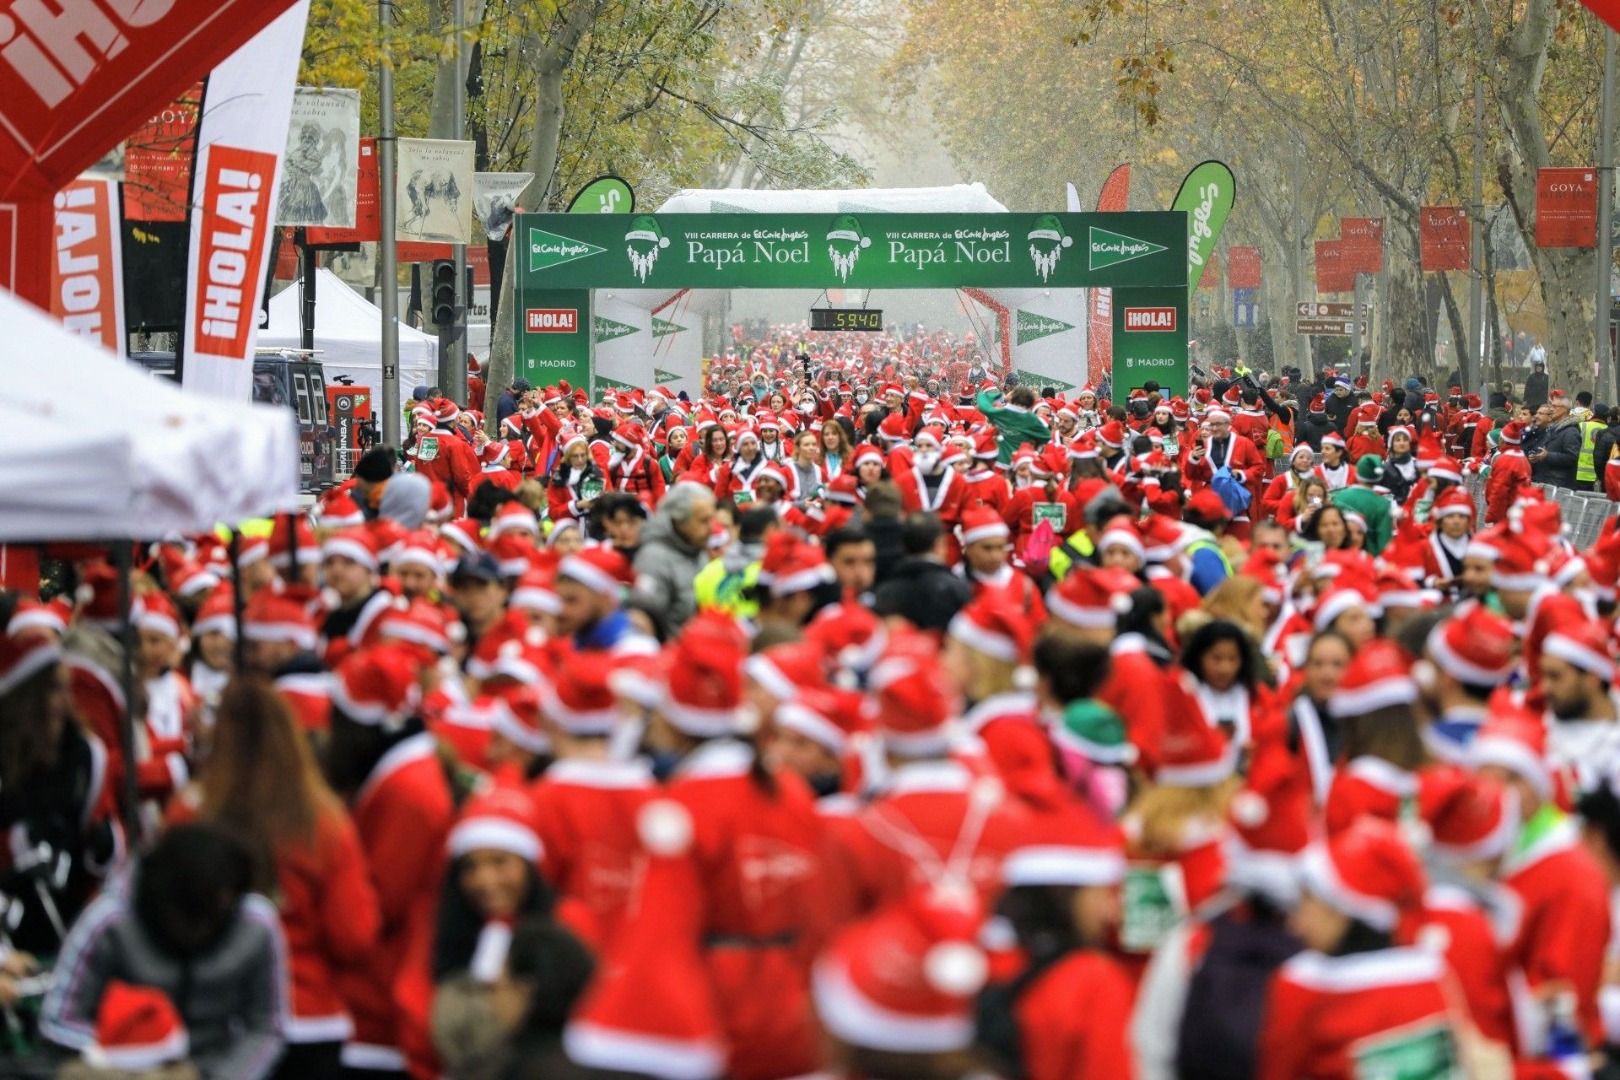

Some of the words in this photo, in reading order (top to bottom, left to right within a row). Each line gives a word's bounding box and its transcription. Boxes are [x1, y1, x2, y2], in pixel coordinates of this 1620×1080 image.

[1550, 183, 1583, 192] GOYA
[741, 231, 751, 239] de
[942, 231, 952, 239] de
[201, 168, 262, 340] ¡HOLA!
[686, 241, 746, 270] Papá
[753, 241, 811, 263] Noel
[888, 241, 947, 270] Papá
[954, 241, 1012, 263] Noel
[529, 312, 573, 328] ¡HOLA!
[1127, 311, 1172, 327] ¡HOLA!
[540, 359, 576, 368] MADRID
[1138, 358, 1175, 367] MADRID
